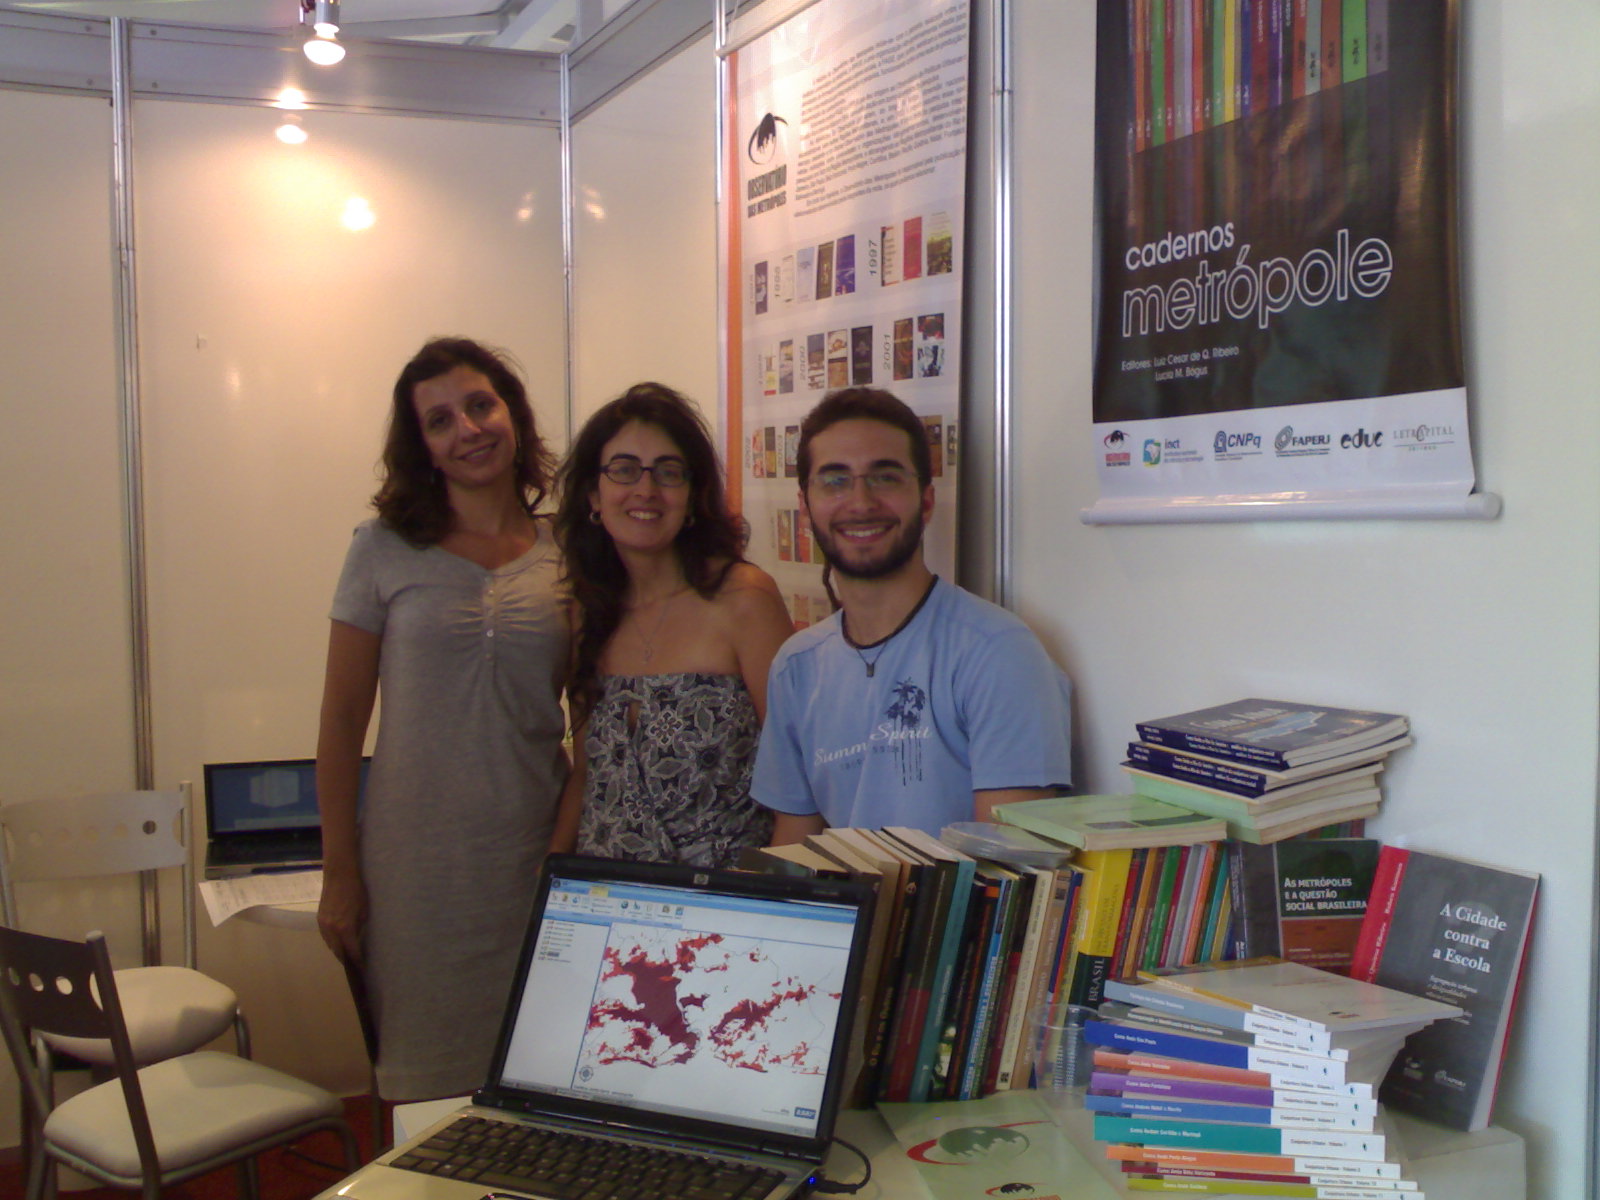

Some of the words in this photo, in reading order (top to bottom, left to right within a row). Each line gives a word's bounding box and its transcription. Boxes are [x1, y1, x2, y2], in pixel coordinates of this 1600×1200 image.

[868, 239, 878, 276] 1997
[1125, 222, 1235, 271] cadernos
[1122, 229, 1393, 338] metrópole
[1227, 432, 1262, 448] CNPq
[1292, 433, 1331, 446] FAPERJ
[1340, 428, 1383, 450] educ
[1298, 877, 1352, 888] METRÓPOLES
[1285, 901, 1315, 911] SOCIAL
[1317, 900, 1367, 910] BRASILEIRA
[1299, 889, 1337, 901] QUESTÃO
[1440, 903, 1452, 917] A
[1456, 906, 1508, 931] Cidade
[1444, 929, 1490, 950] contra
[1432, 948, 1441, 960] a
[1444, 948, 1491, 973] Escola
[1088, 958, 1105, 1002] BRASIL
